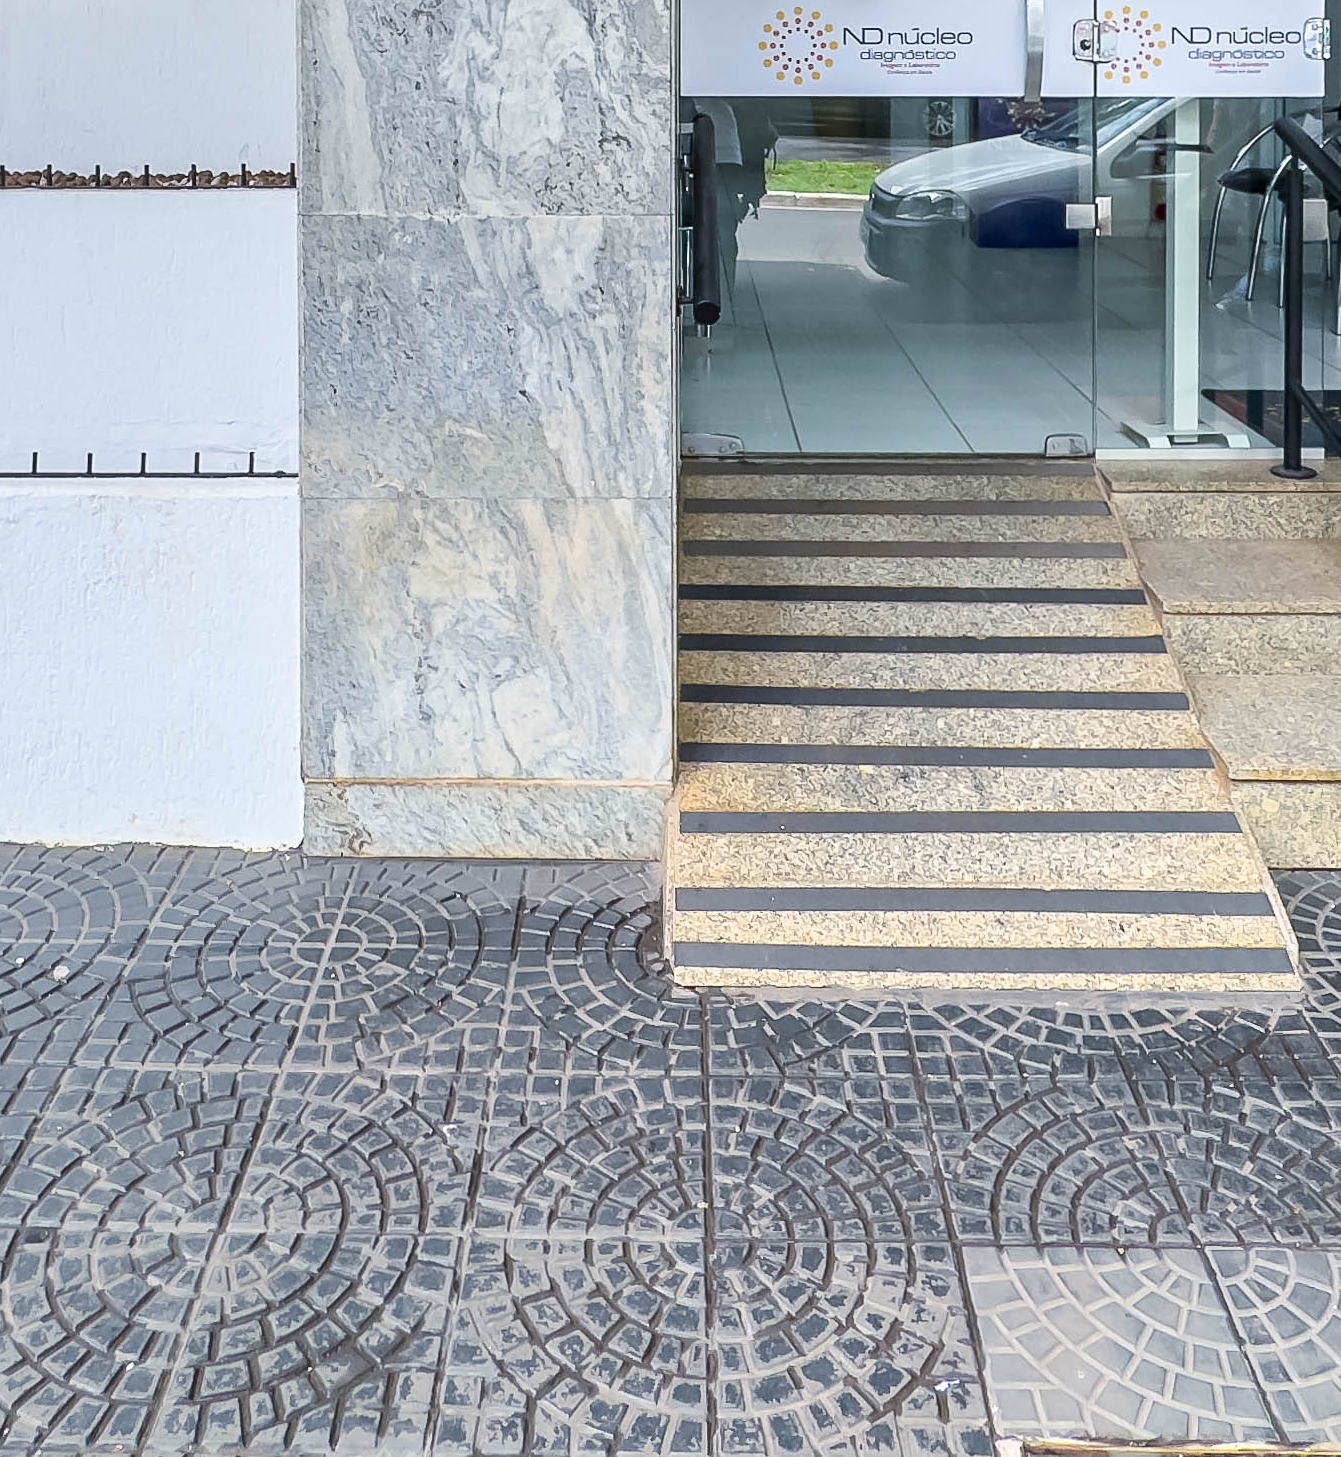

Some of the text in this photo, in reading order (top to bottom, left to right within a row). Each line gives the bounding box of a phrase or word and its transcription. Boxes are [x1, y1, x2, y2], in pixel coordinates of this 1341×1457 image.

[843, 27, 973, 46] ND núcleo
[1171, 26, 1301, 45] ND núcleo
[859, 48, 957, 63] diagnóstico
